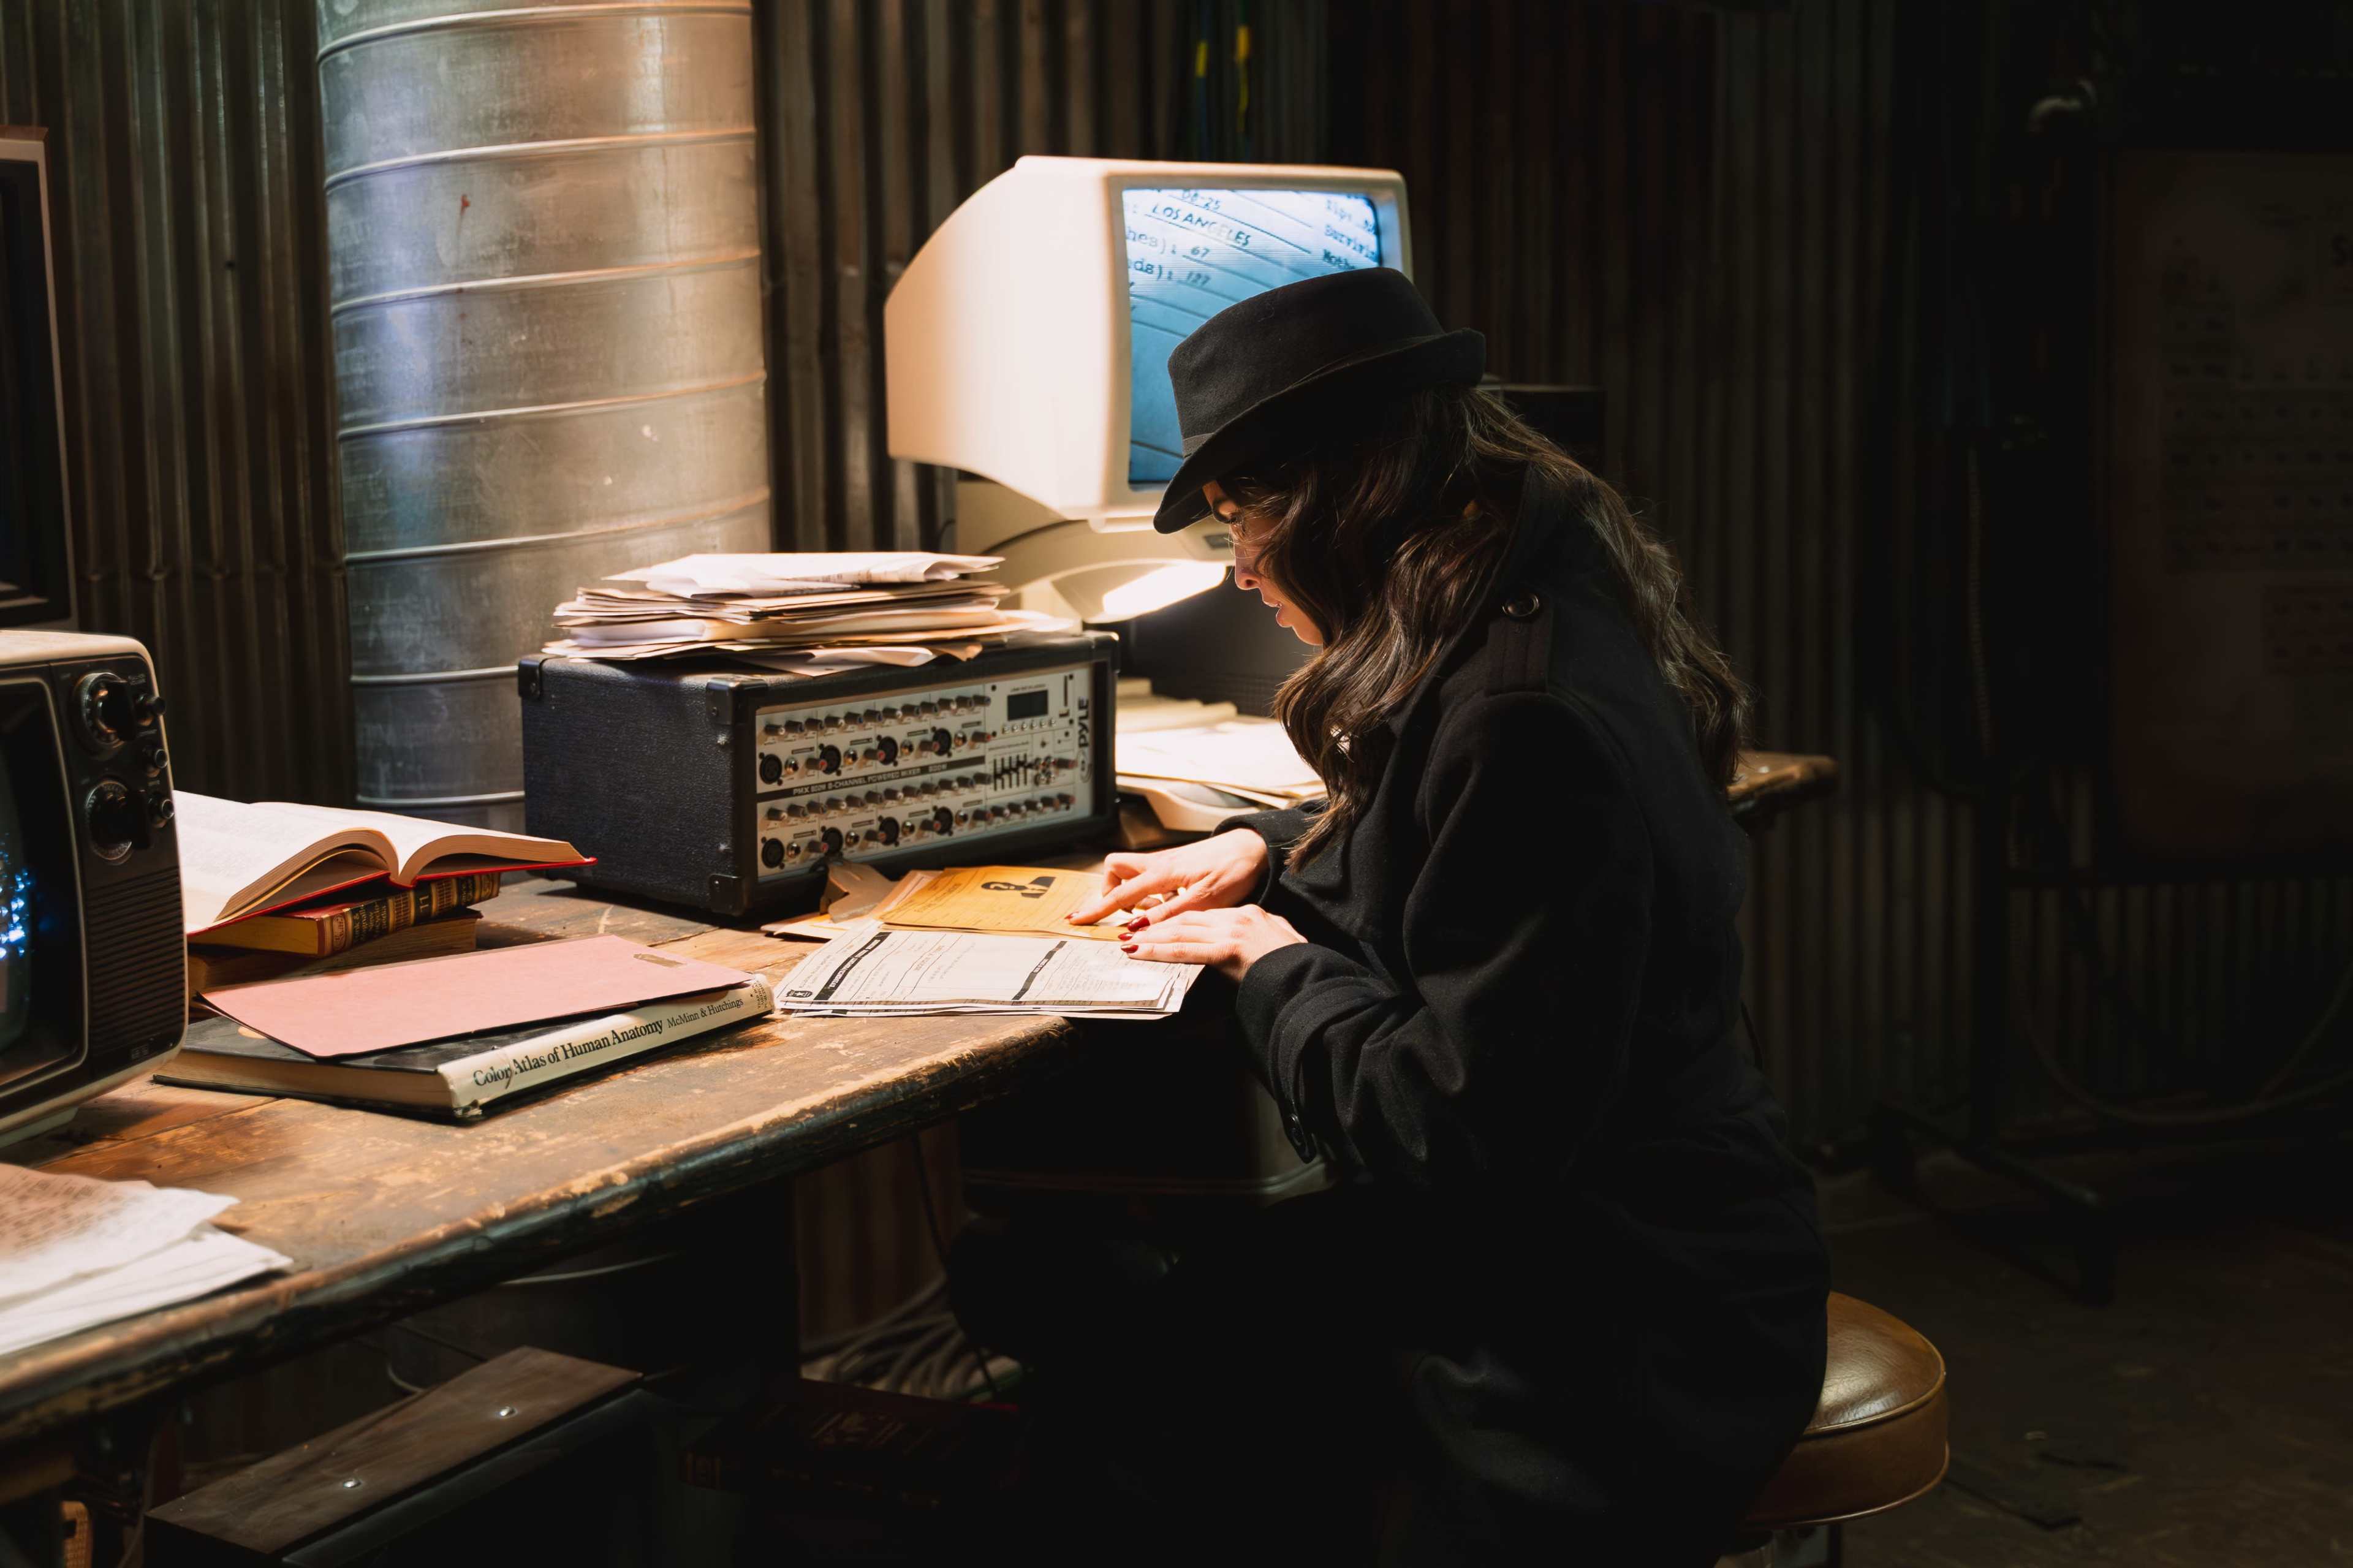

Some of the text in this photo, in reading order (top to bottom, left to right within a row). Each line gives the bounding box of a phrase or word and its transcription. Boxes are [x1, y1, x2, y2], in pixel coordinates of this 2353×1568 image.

[1151, 203, 1252, 246] LOS ANGELES
[1078, 697, 1089, 748] PYLE
[473, 998, 744, 1086] Color Atlas of Human Anatomy McMinn & Hutchings
